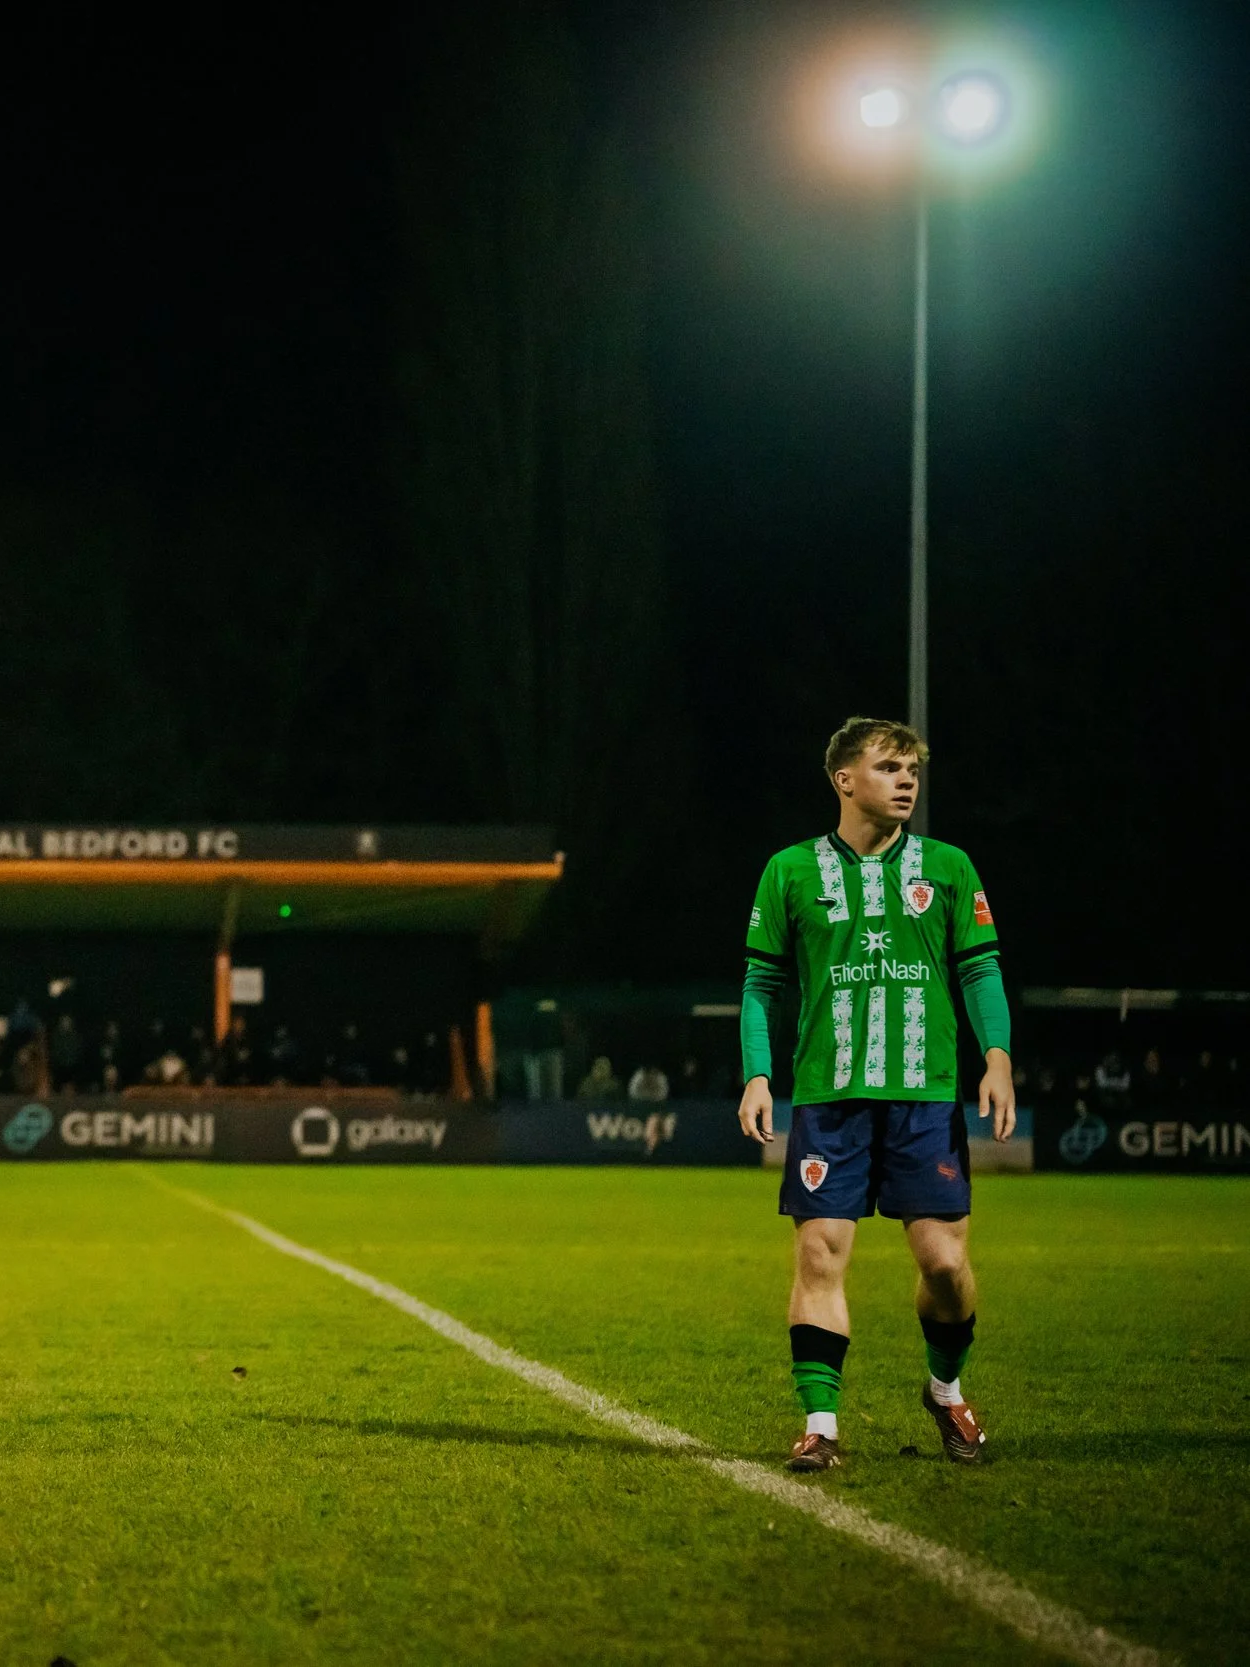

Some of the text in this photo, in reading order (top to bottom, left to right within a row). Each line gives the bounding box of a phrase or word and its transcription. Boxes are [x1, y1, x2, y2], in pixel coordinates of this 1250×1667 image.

[41, 830, 189, 858] BEDFORD
[196, 830, 239, 858] FC
[881, 959, 930, 981] Nash
[60, 1110, 215, 1147] GEMINI
[347, 1113, 448, 1151] galaxy
